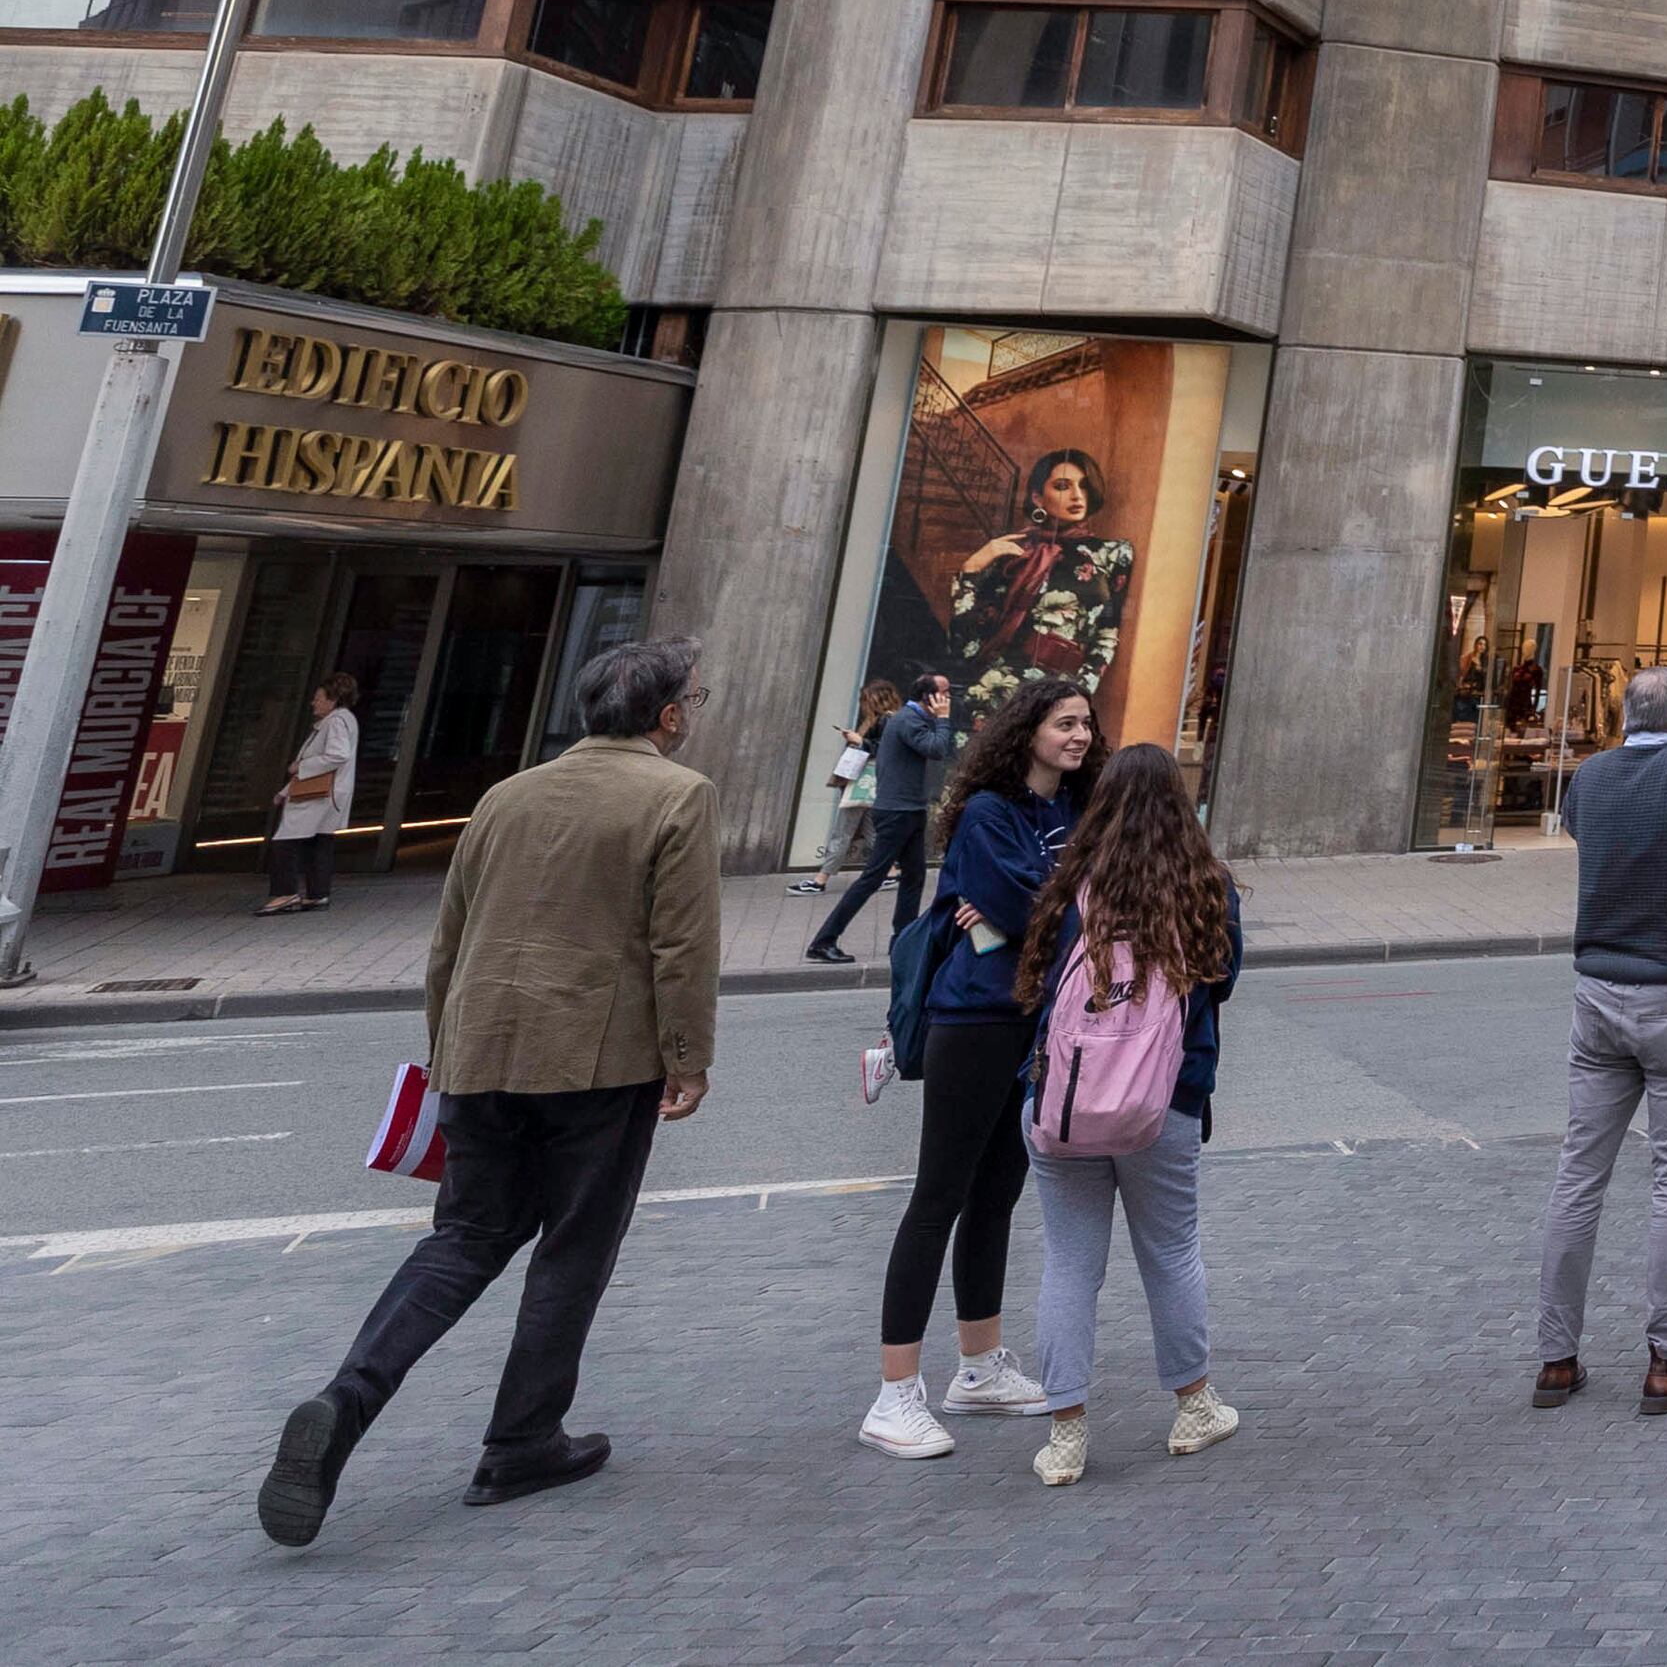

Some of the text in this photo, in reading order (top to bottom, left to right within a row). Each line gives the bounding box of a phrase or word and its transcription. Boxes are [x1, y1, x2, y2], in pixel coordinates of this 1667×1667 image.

[103, 319, 178, 334] FUENSANTA
[137, 289, 194, 306] PLAZA
[138, 306, 184, 319] DE LA
[224, 328, 529, 427] EDIFICIO
[206, 422, 520, 510] HISPANIA
[70, 635, 163, 775] MURCIA
[46, 780, 125, 870] REAL
